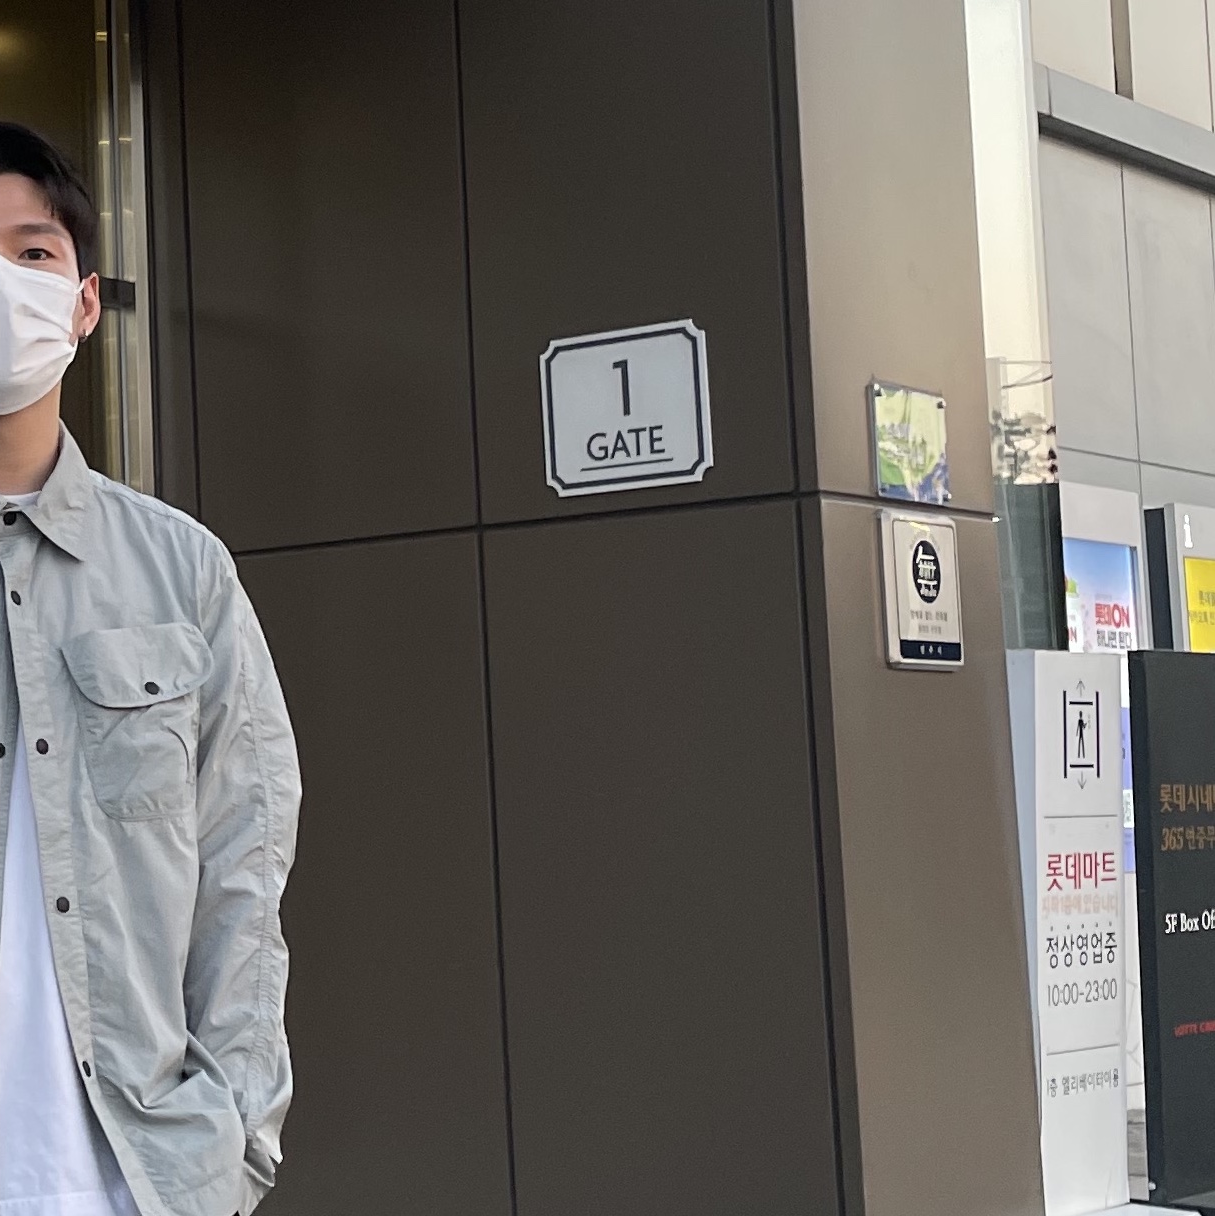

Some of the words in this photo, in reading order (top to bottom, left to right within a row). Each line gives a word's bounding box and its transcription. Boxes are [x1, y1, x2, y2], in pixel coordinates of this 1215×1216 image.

[612, 359, 631, 417] 1
[586, 425, 666, 461] GATE
[1046, 851, 1117, 892] 롯데마트
[1083, 891, 1119, 917] 있습니다
[1165, 913, 1178, 934] 5F
[1180, 912, 1199, 932] Box
[1046, 932, 1117, 969] 정상영업중
[1047, 978, 1118, 1007] 10:00-23:00
